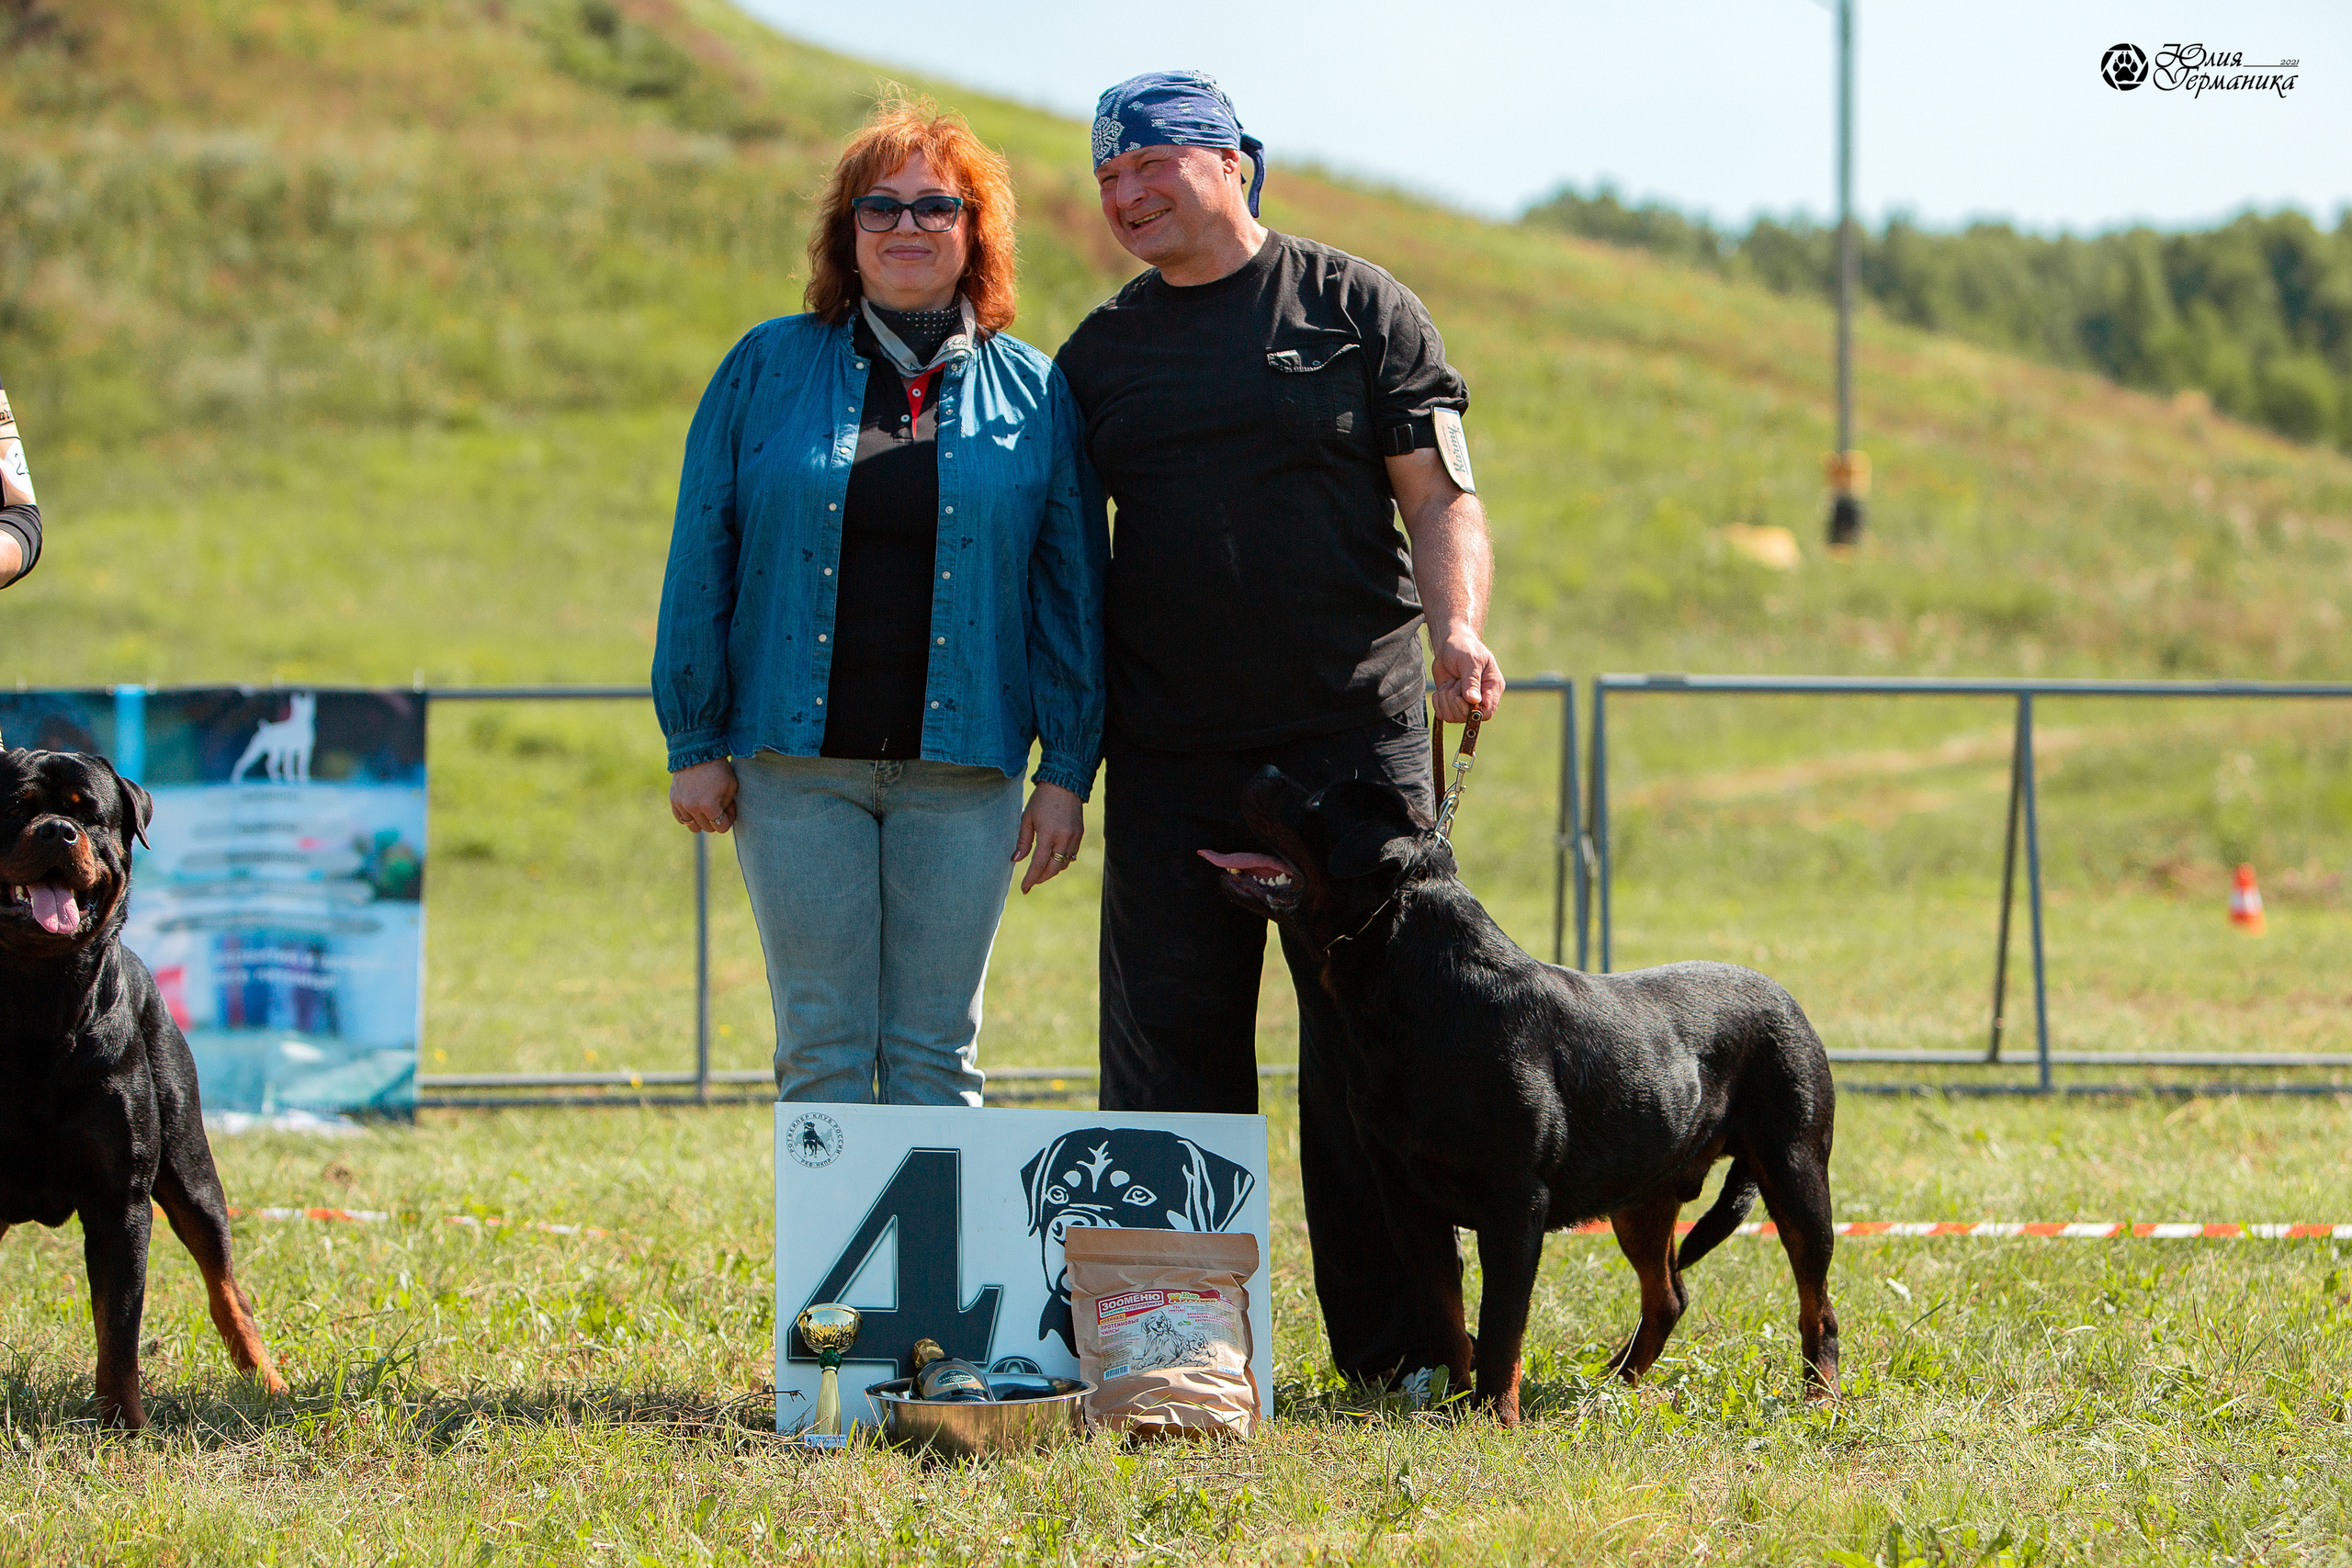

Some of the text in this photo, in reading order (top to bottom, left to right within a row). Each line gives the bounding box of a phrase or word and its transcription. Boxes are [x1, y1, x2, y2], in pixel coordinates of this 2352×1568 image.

[787, 1146, 1004, 1380] 4
[1102, 1293, 1160, 1311] ЗООМЕНЮ
[1101, 1318, 1139, 1330] ПРОТЕИНОВЫЕ
